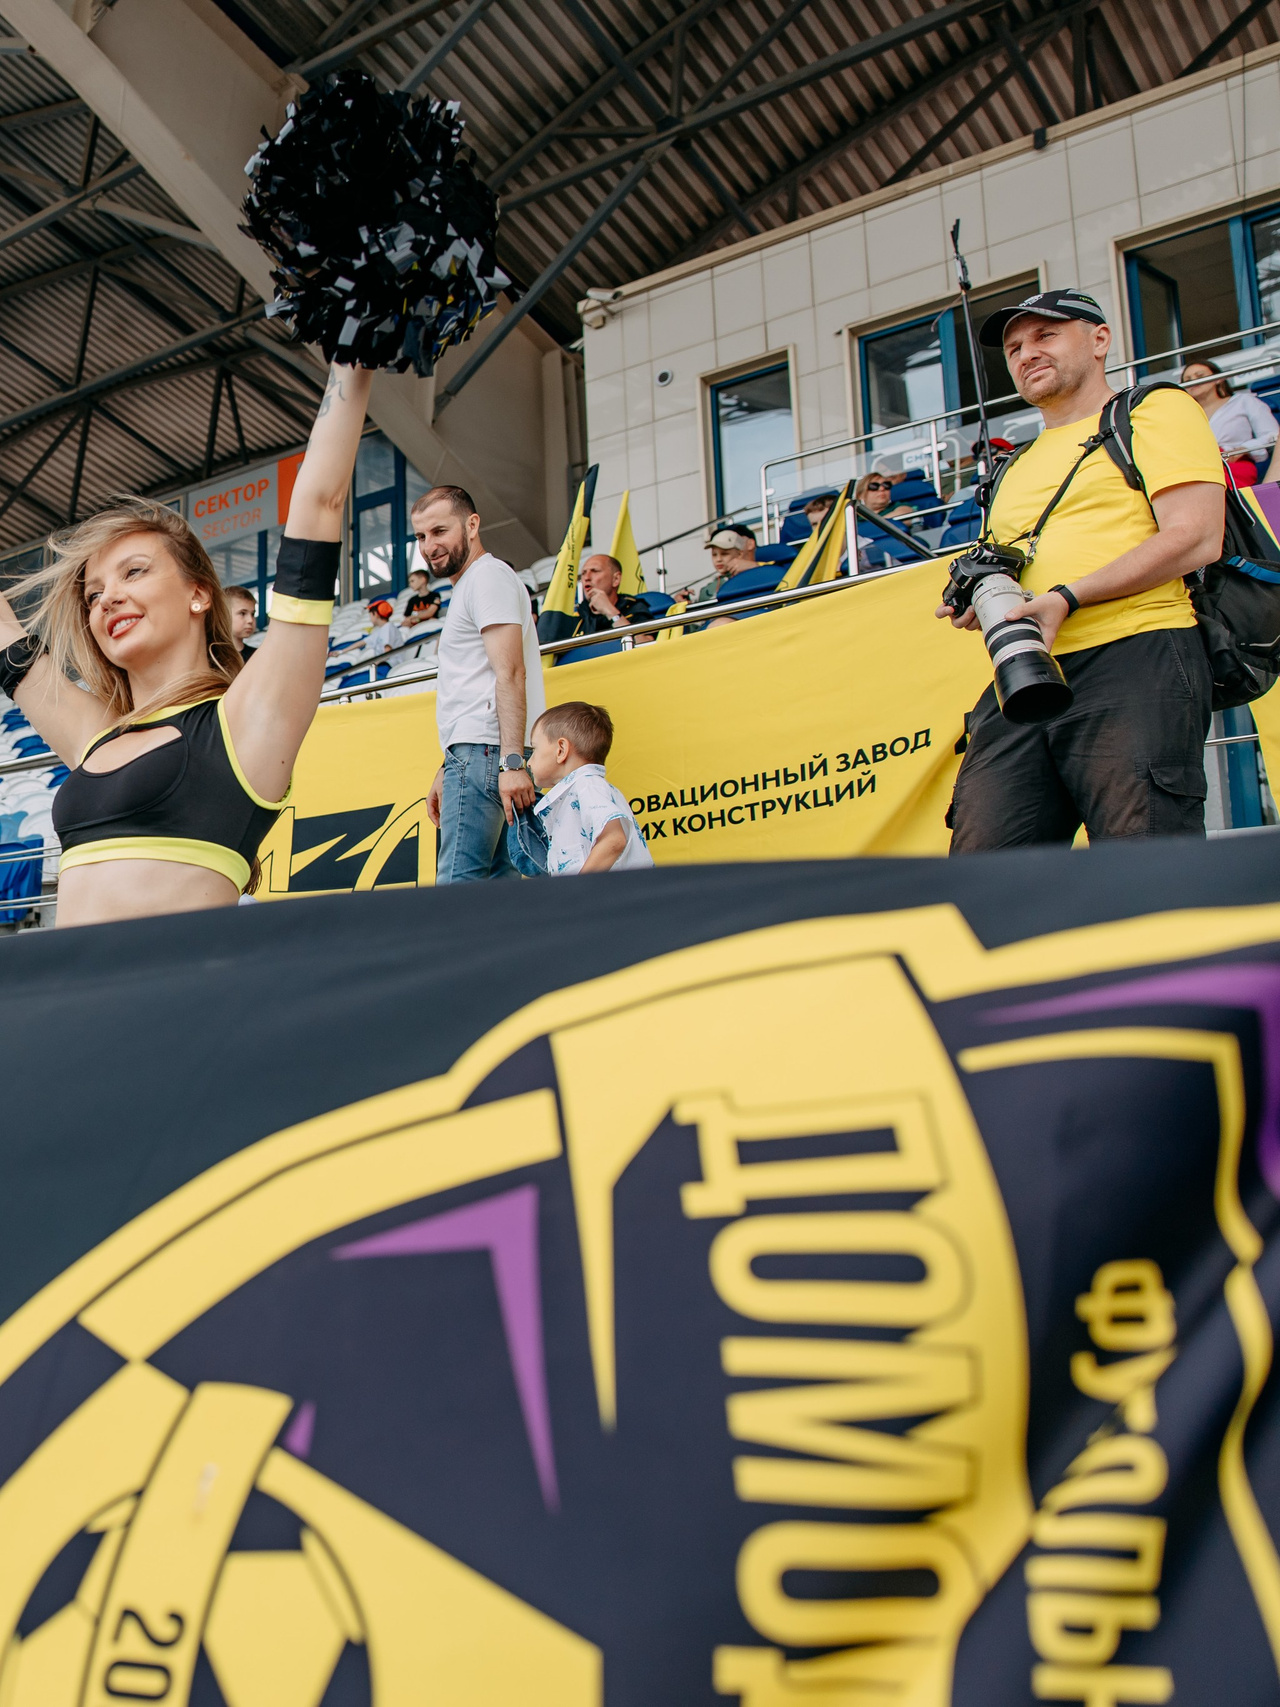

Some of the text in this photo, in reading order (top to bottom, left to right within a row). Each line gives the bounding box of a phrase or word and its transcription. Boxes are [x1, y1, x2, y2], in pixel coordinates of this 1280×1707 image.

[194, 478, 270, 518] СЕКТОР
[202, 508, 262, 540] SECTOR
[567, 564, 575, 589] RUS
[836, 728, 932, 773] ЗАВОД
[672, 770, 877, 836] КОНСТРУКЦИЙ
